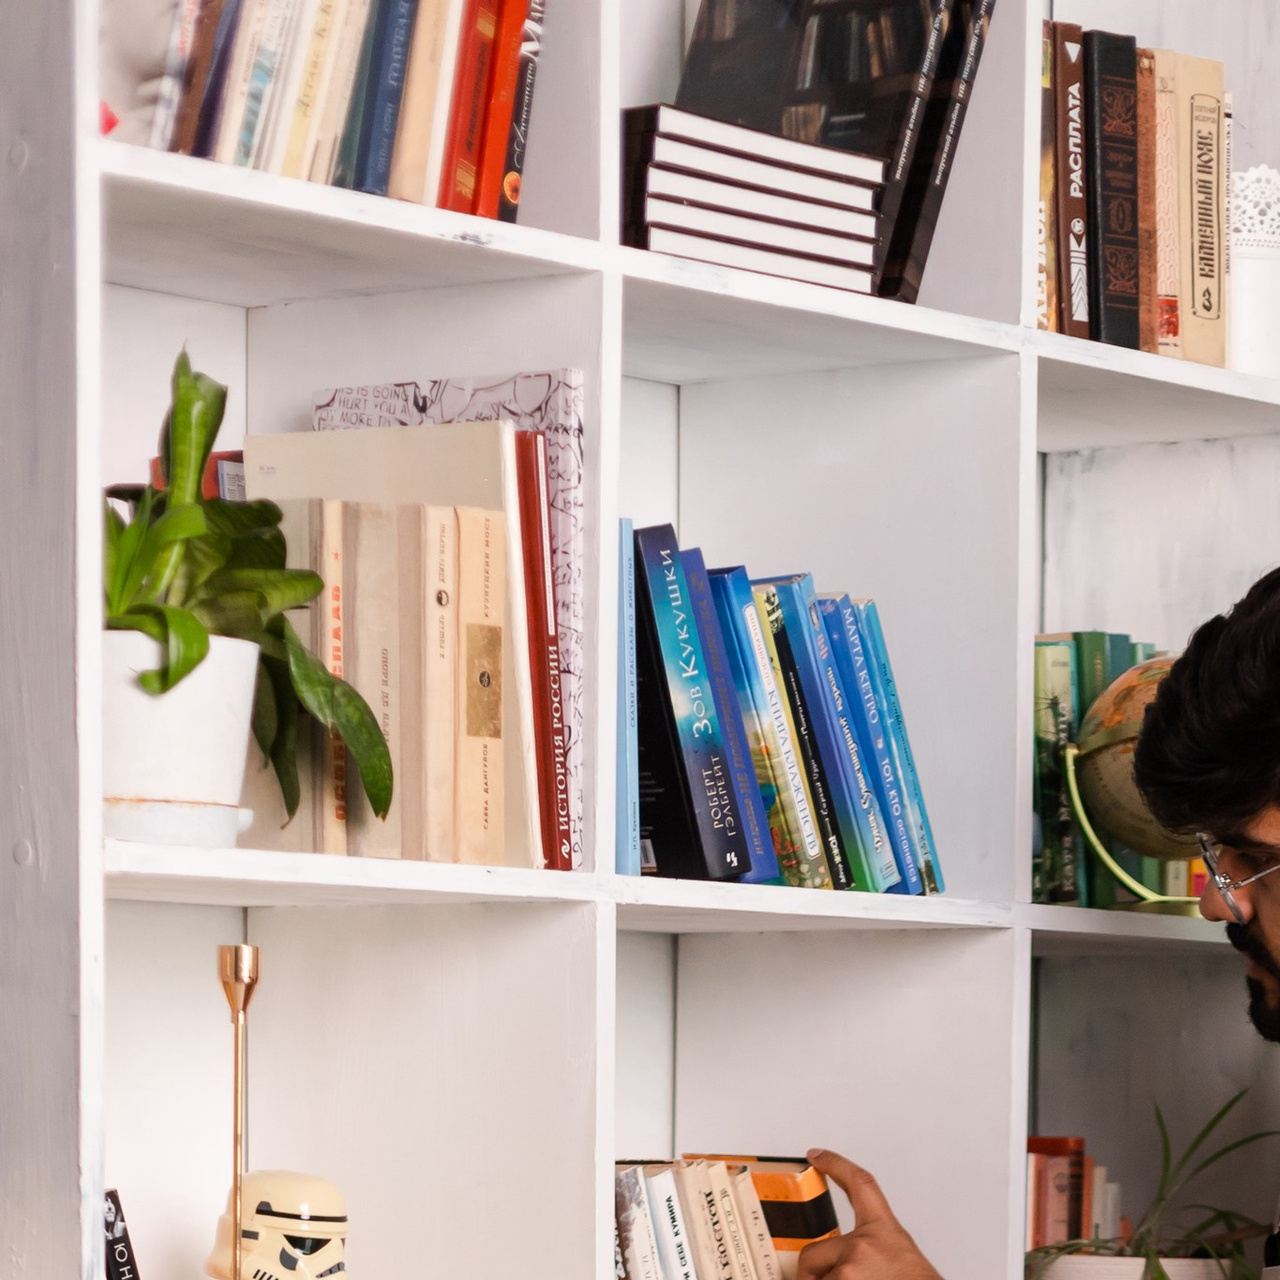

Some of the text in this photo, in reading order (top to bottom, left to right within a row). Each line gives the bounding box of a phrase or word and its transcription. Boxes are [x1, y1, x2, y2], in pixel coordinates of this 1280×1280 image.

[892, 129, 913, 179] выпускной
[906, 96, 921, 128] альбом
[933, 135, 953, 184] выпускной
[946, 102, 962, 134] альбом
[1067, 81, 1083, 198] РАСПЛАТА
[1196, 130, 1214, 279] КАМЕННЫЙ ПОЯС
[841, 607, 880, 724] МАРТА КЕТРО
[332, 730, 345, 820] ОСОБ
[544, 644, 572, 830] ИСТОРИЯ РОССИИ
[765, 689, 789, 742] КНИГА
[781, 748, 819, 850] БЛАЖЕНСТВ
[701, 767, 724, 829] РОБЕРТ
[705, 753, 741, 836] ГЭЛБРЕЙТ
[878, 756, 895, 787] ТОТ,
[887, 789, 902, 816] КТО
[112, 1242, 129, 1263] Ю
[664, 1195, 681, 1236] КУМИРА
[674, 1241, 688, 1267] СЕБЕ
